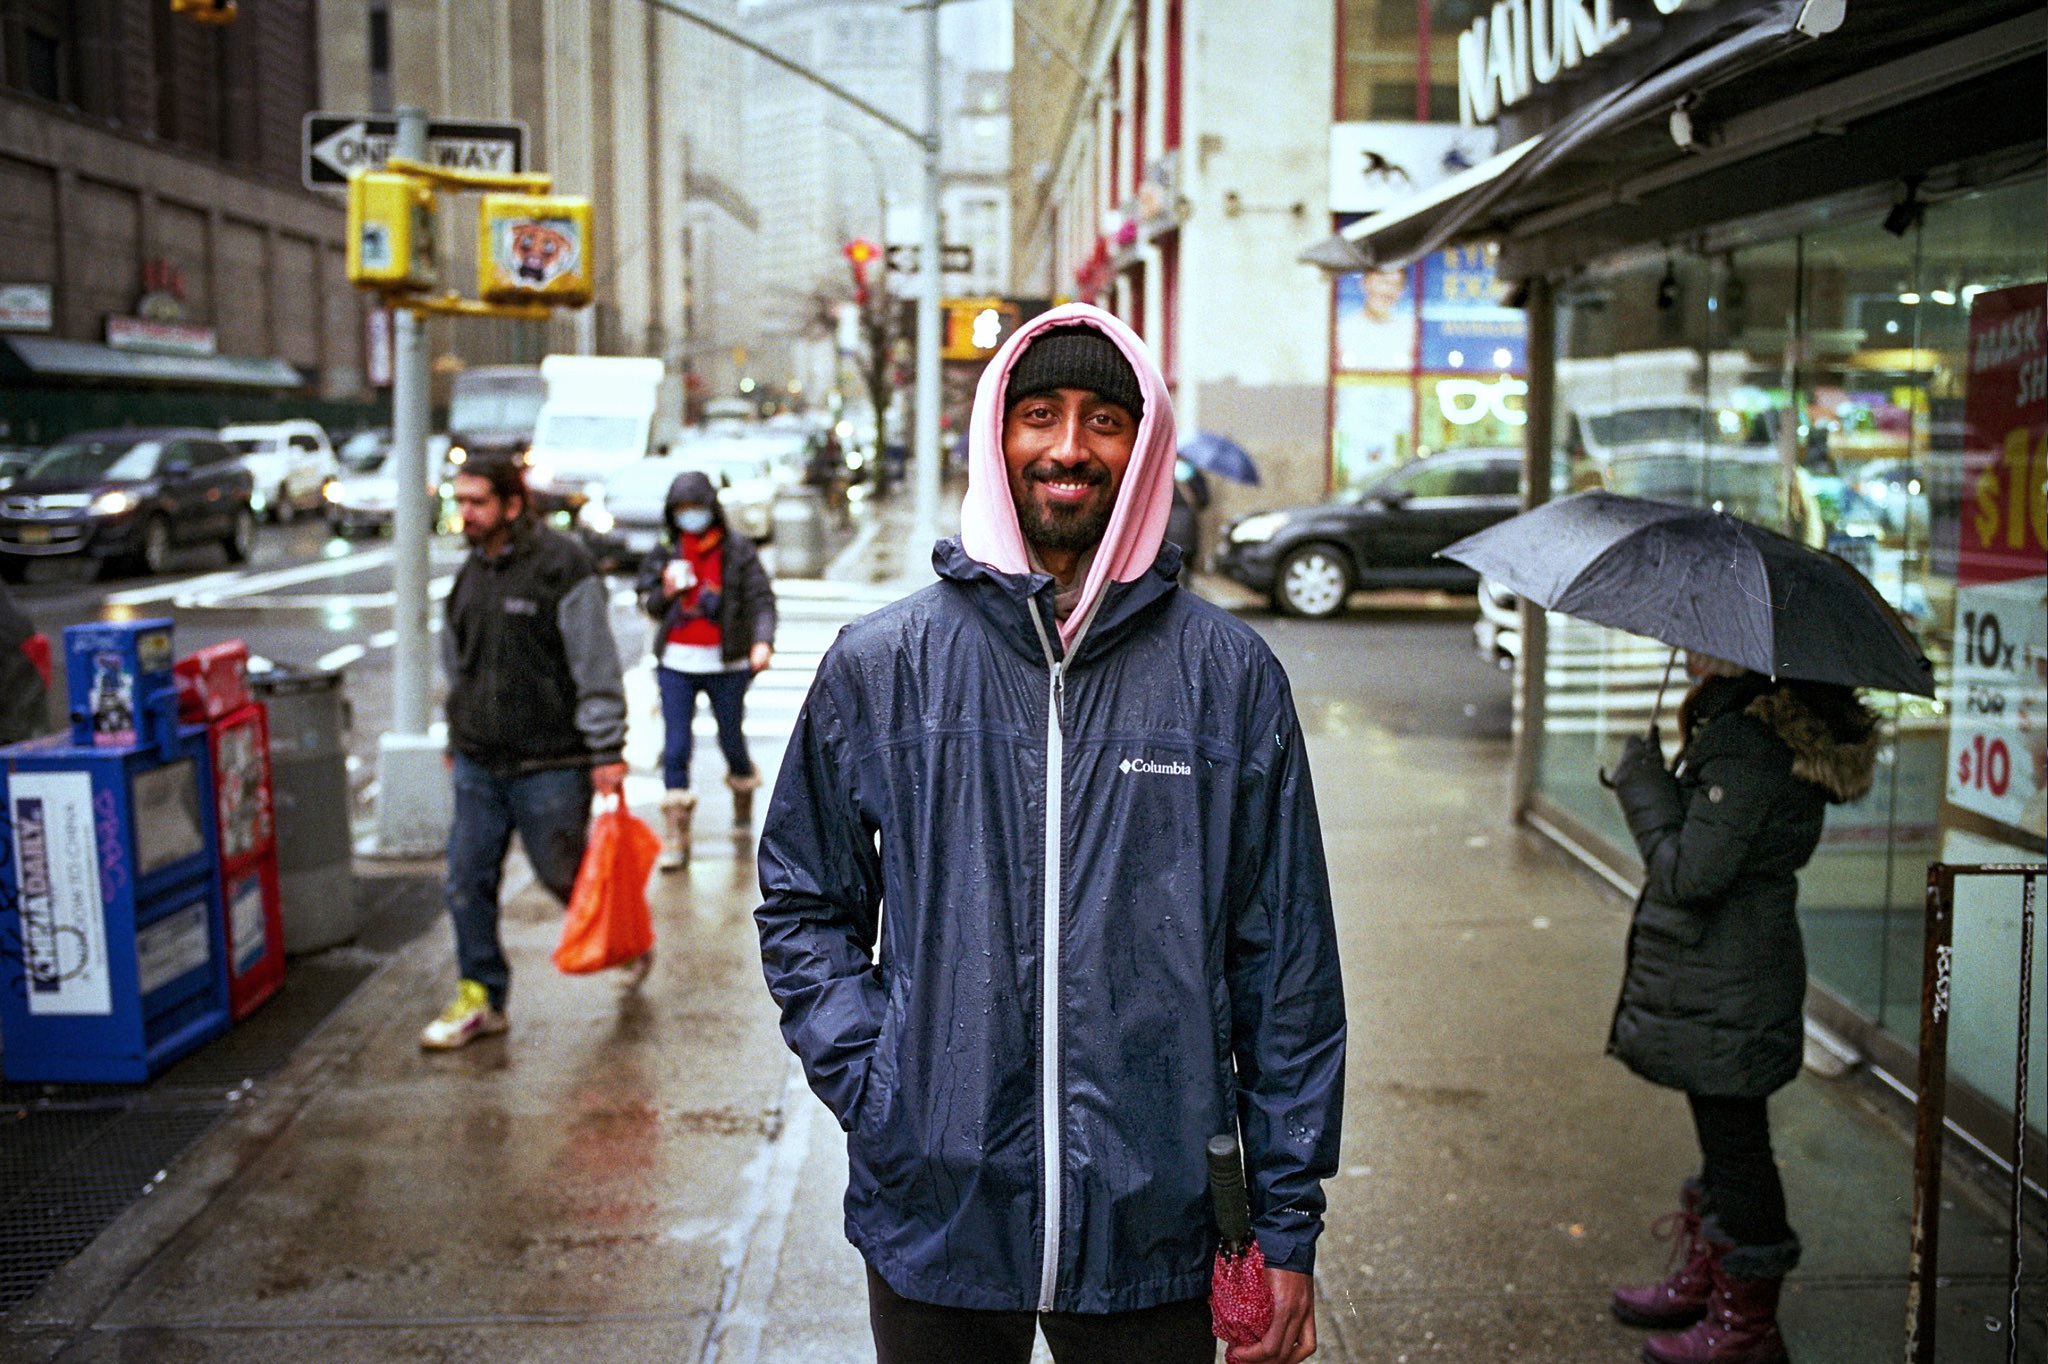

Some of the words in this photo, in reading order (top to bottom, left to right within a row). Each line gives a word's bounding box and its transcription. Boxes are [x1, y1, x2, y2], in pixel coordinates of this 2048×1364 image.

[437, 146, 505, 170] WAY
[1973, 305, 2041, 374] MASK
[1968, 685, 2006, 715] FOR
[1131, 758, 1191, 775] Columbia
[1958, 733, 2011, 798] $10
[18, 816, 48, 896] DAILY
